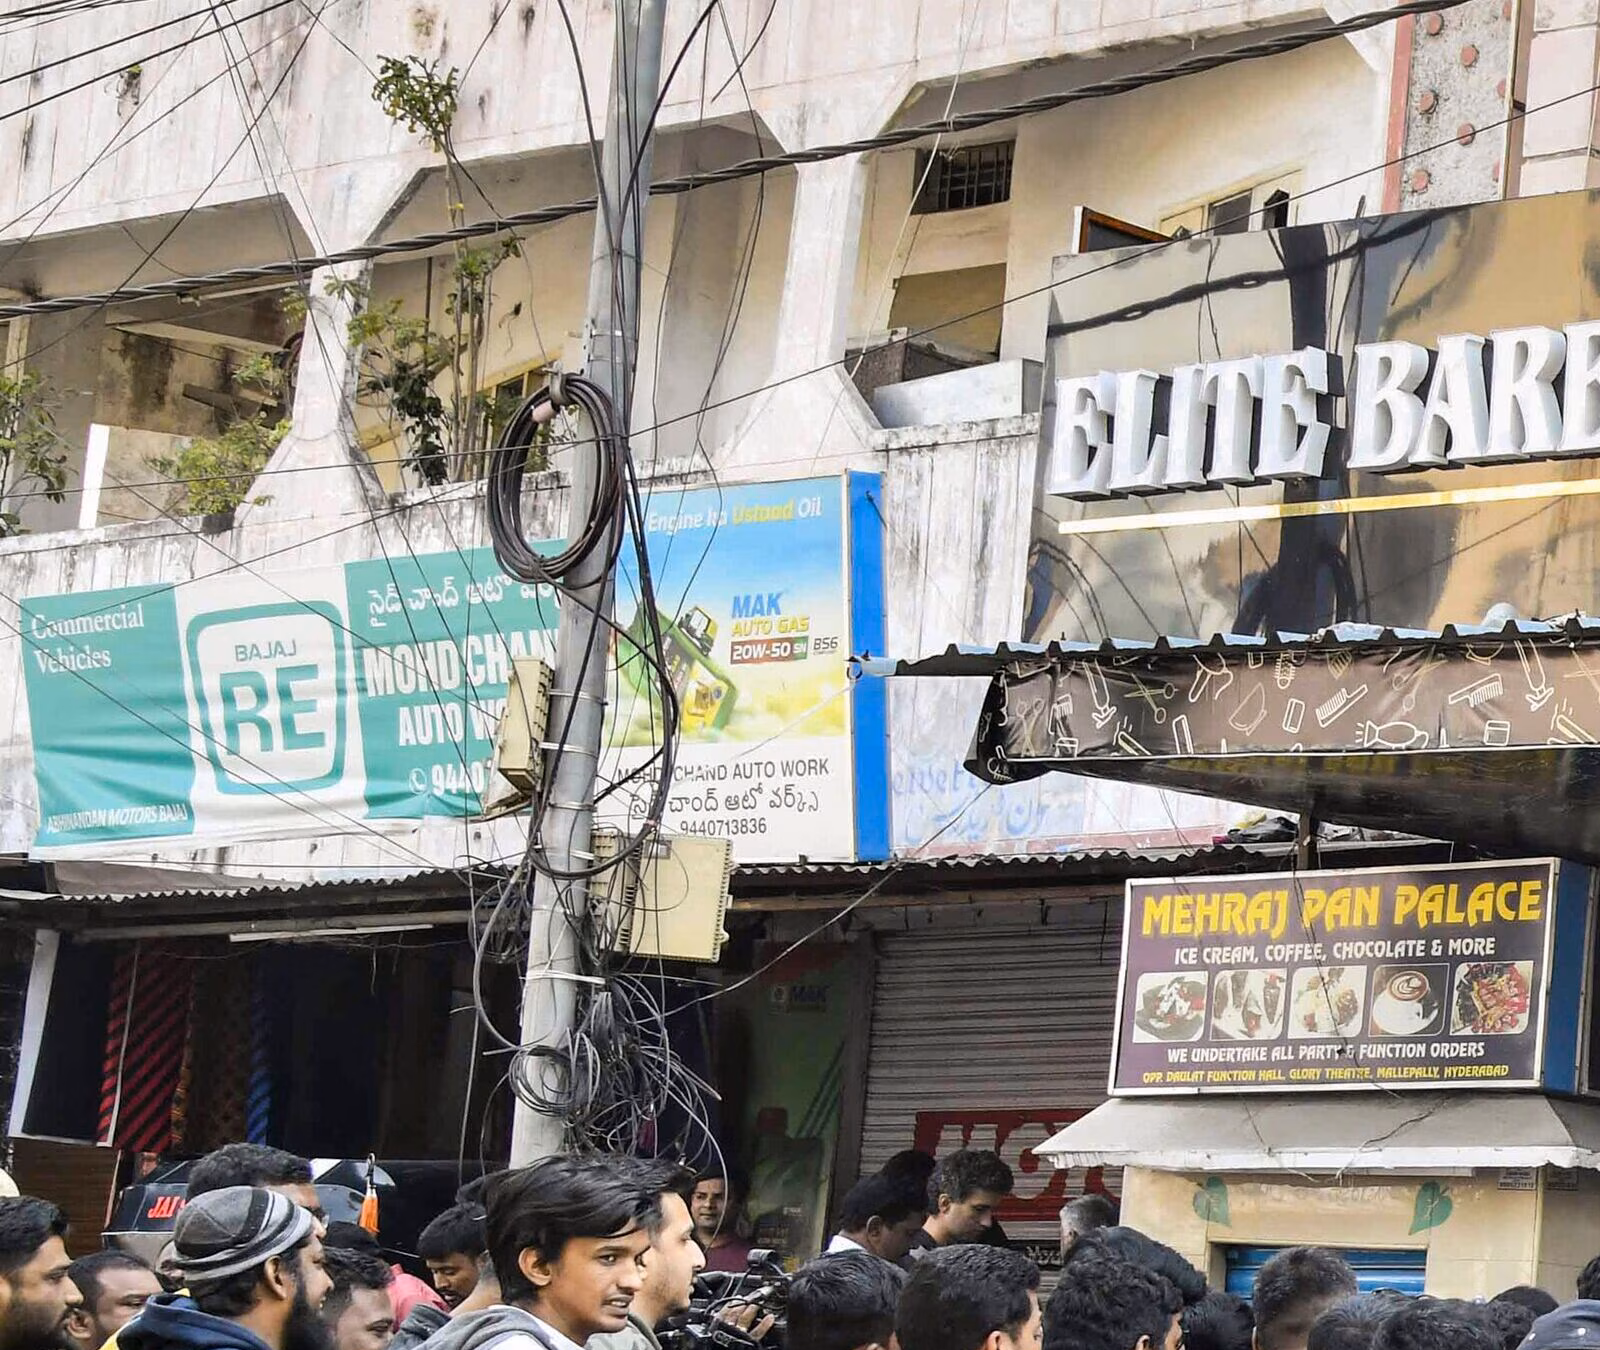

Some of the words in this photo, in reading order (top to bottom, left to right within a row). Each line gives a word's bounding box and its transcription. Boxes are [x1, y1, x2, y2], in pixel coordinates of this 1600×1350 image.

[1048, 345, 1338, 498] ELITE
[649, 512, 707, 537] Engine
[732, 501, 796, 526] Ustaad
[797, 496, 822, 519] Oil
[731, 593, 784, 619] MAK
[31, 602, 146, 641] Commercial
[731, 618, 773, 638] AUTO
[777, 616, 811, 634] GAS
[33, 644, 112, 674] Vehicles
[234, 639, 298, 662] BAJAJ
[733, 642, 792, 661] 20W-50
[363, 639, 461, 698] MOHD
[220, 660, 330, 757] RE
[399, 701, 465, 747] AUTO
[673, 764, 728, 783] CHAND
[732, 761, 776, 780] AUTO
[781, 758, 830, 778] WORK
[680, 817, 768, 836] 9440713836
[1142, 890, 1290, 941] MEHRAJ
[1302, 886, 1381, 933] PAN
[1393, 880, 1542, 929] PALACE
[1174, 947, 1198, 965] ICE
[1203, 945, 1259, 966] CREAM,
[1265, 942, 1327, 962] COFFEE,
[1333, 939, 1426, 961] CHOCOLATE
[1431, 939, 1443, 957] &
[1448, 937, 1496, 957] MORE
[1167, 1048, 1188, 1063] WE
[1191, 1047, 1268, 1063] UNDERTAKE
[1272, 1046, 1295, 1062] ALL
[1299, 1044, 1342, 1061] PARTY
[1359, 1043, 1430, 1060] FUNCTION
[1430, 1042, 1485, 1058] ORDERS
[1166, 1070, 1206, 1083] DAULAT
[1207, 1069, 1256, 1083] FUNCTION
[1289, 1068, 1322, 1081] GLORY
[1443, 1065, 1509, 1078] HYDERABAD
